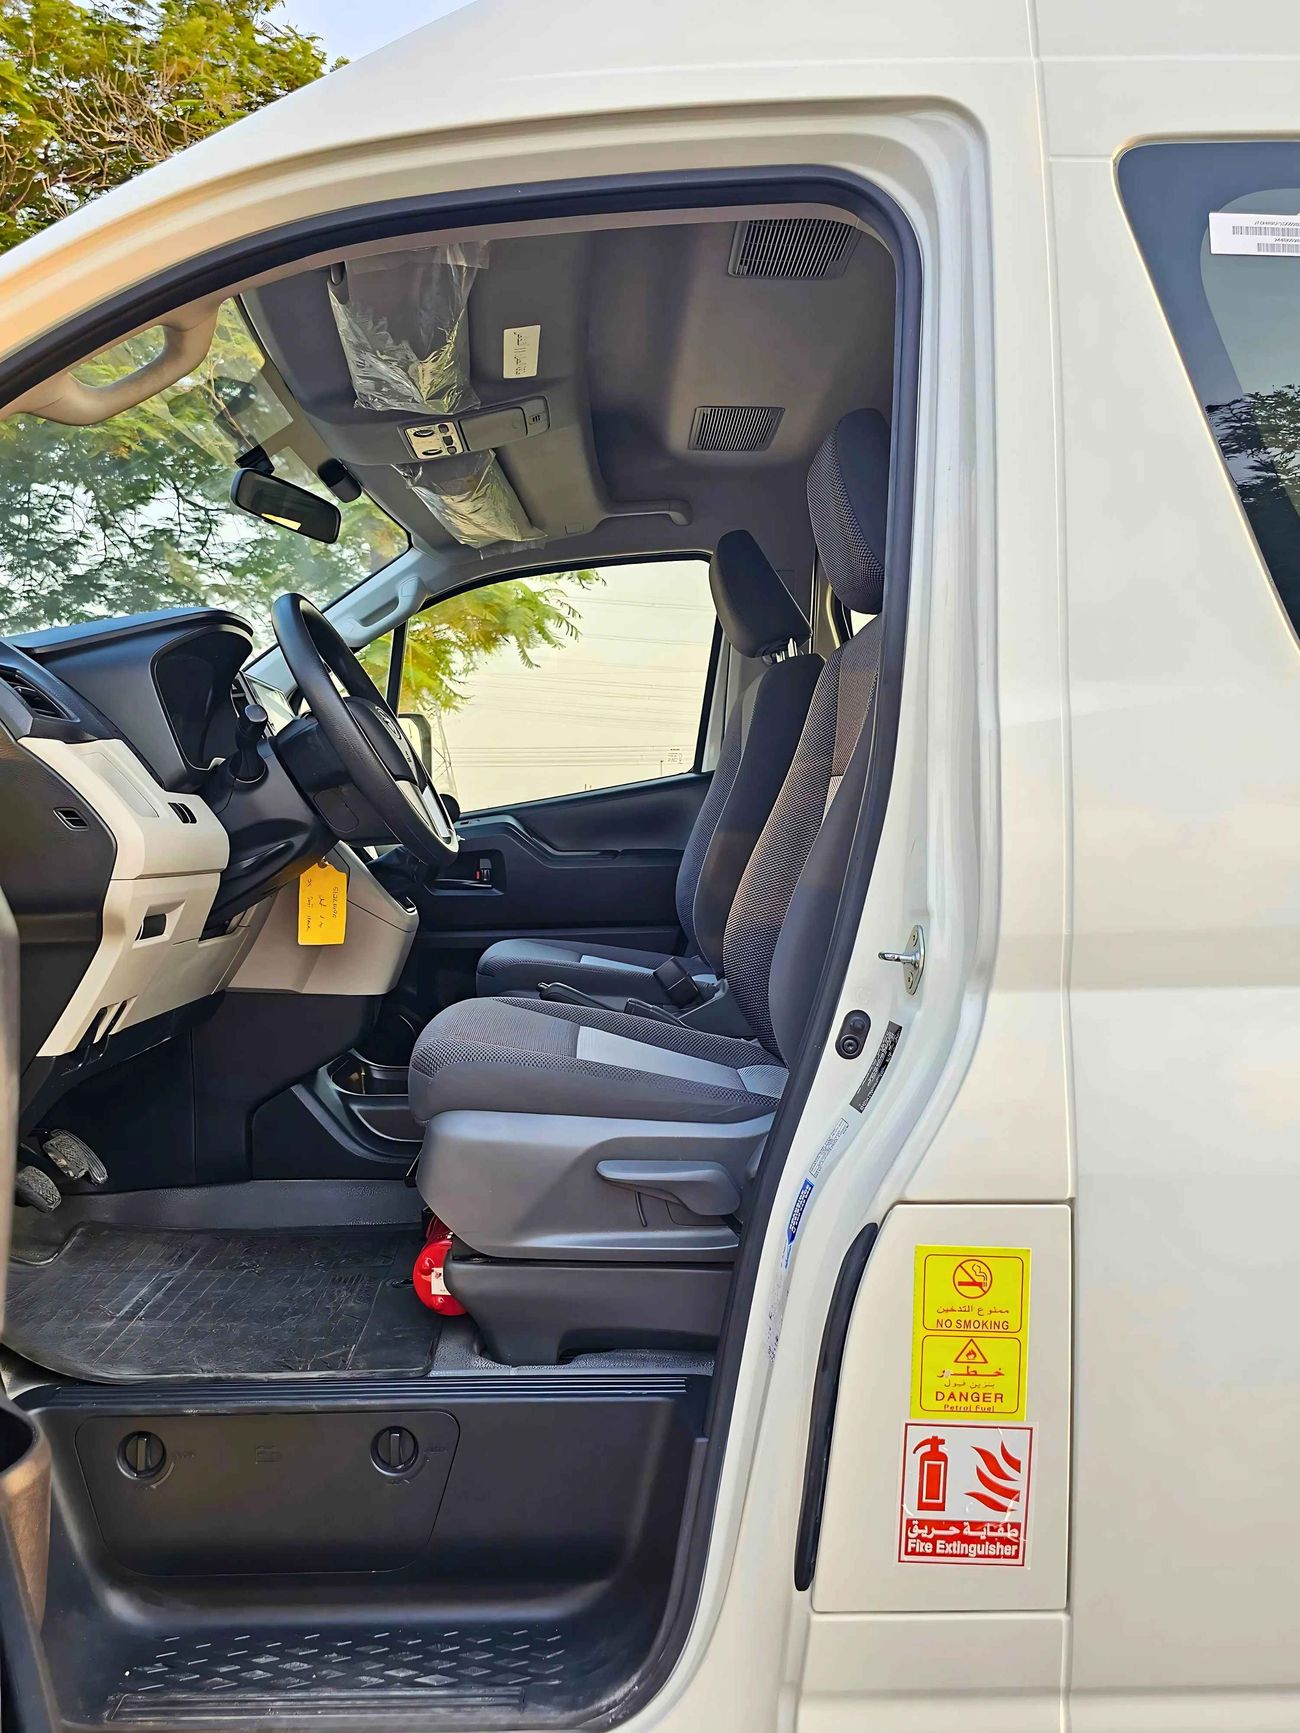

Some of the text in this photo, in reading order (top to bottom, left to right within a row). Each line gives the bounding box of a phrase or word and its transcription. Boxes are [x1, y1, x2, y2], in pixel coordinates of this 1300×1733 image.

[937, 1305, 973, 1314] التدخين
[936, 1318, 1009, 1330] NO SMOKING
[935, 1391, 1004, 1403] DANGER
[944, 1404, 995, 1412] Petrol Fuel
[907, 1520, 1019, 1540] طفاية حريق
[907, 1538, 1018, 1557] Fire Extinguisher
